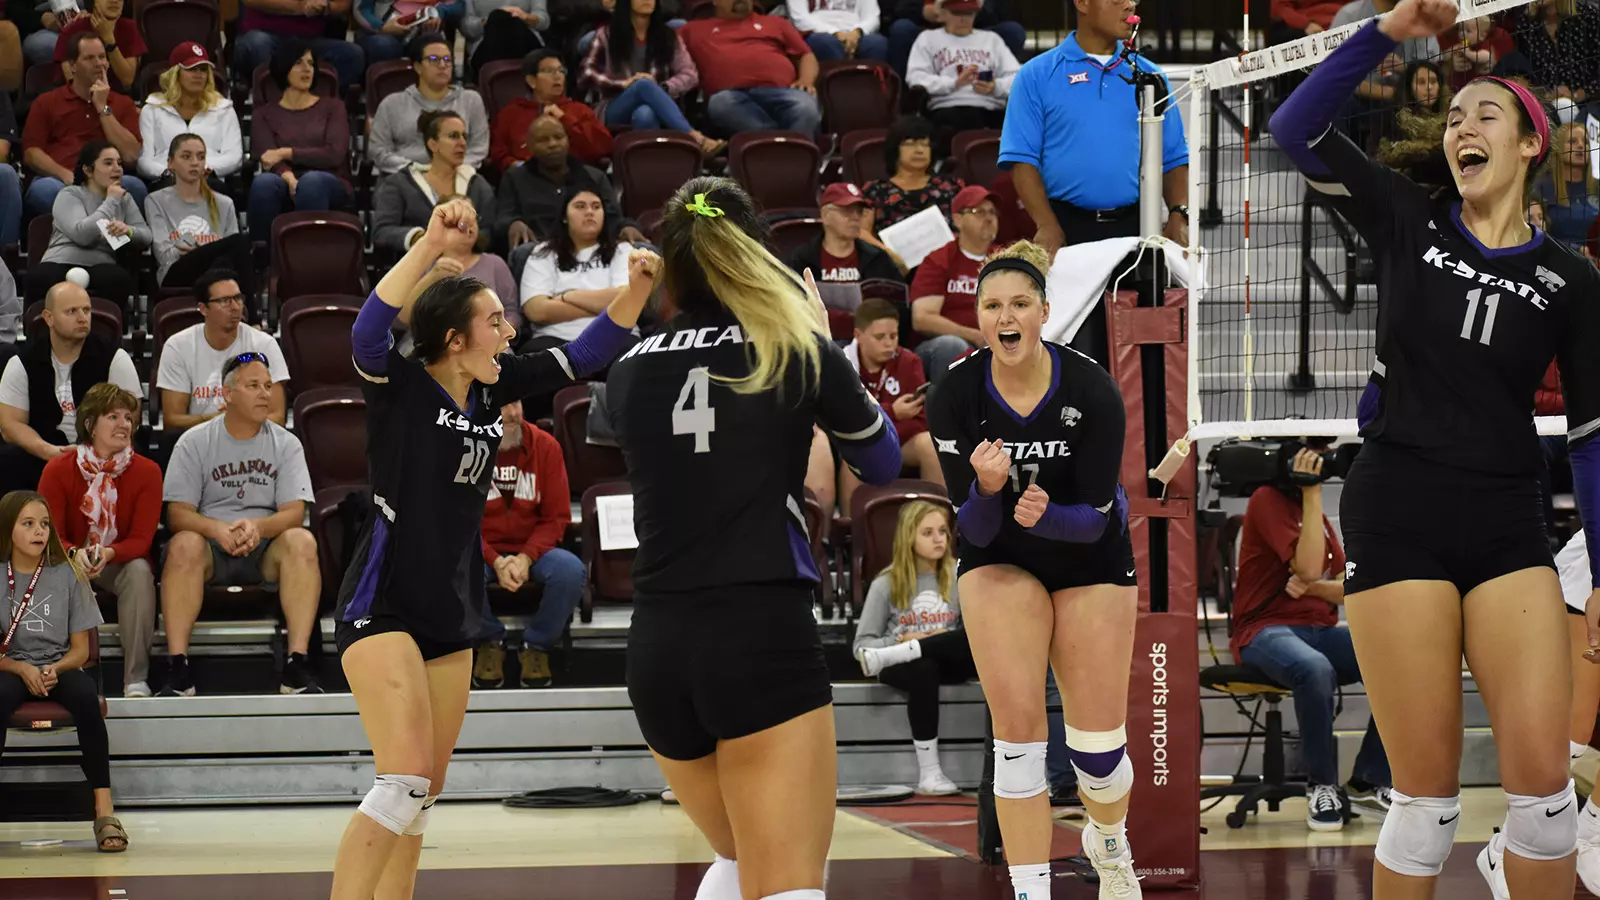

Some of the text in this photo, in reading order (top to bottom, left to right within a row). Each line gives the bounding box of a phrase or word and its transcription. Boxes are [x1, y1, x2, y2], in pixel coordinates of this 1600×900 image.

[1422, 245, 1549, 311] K-STATE
[1460, 288, 1500, 346] 11
[619, 325, 754, 362] WILDCA
[436, 407, 504, 438] K-STE
[672, 366, 715, 453] 4
[453, 437, 490, 485] 20
[1000, 440, 1071, 460] STATE
[211, 458, 279, 482] OKLAHOMA
[221, 476, 268, 488] VOLLBALL
[1009, 463, 1040, 493] 17
[899, 611, 917, 625] All
[1149, 642, 1169, 786] sports imports
